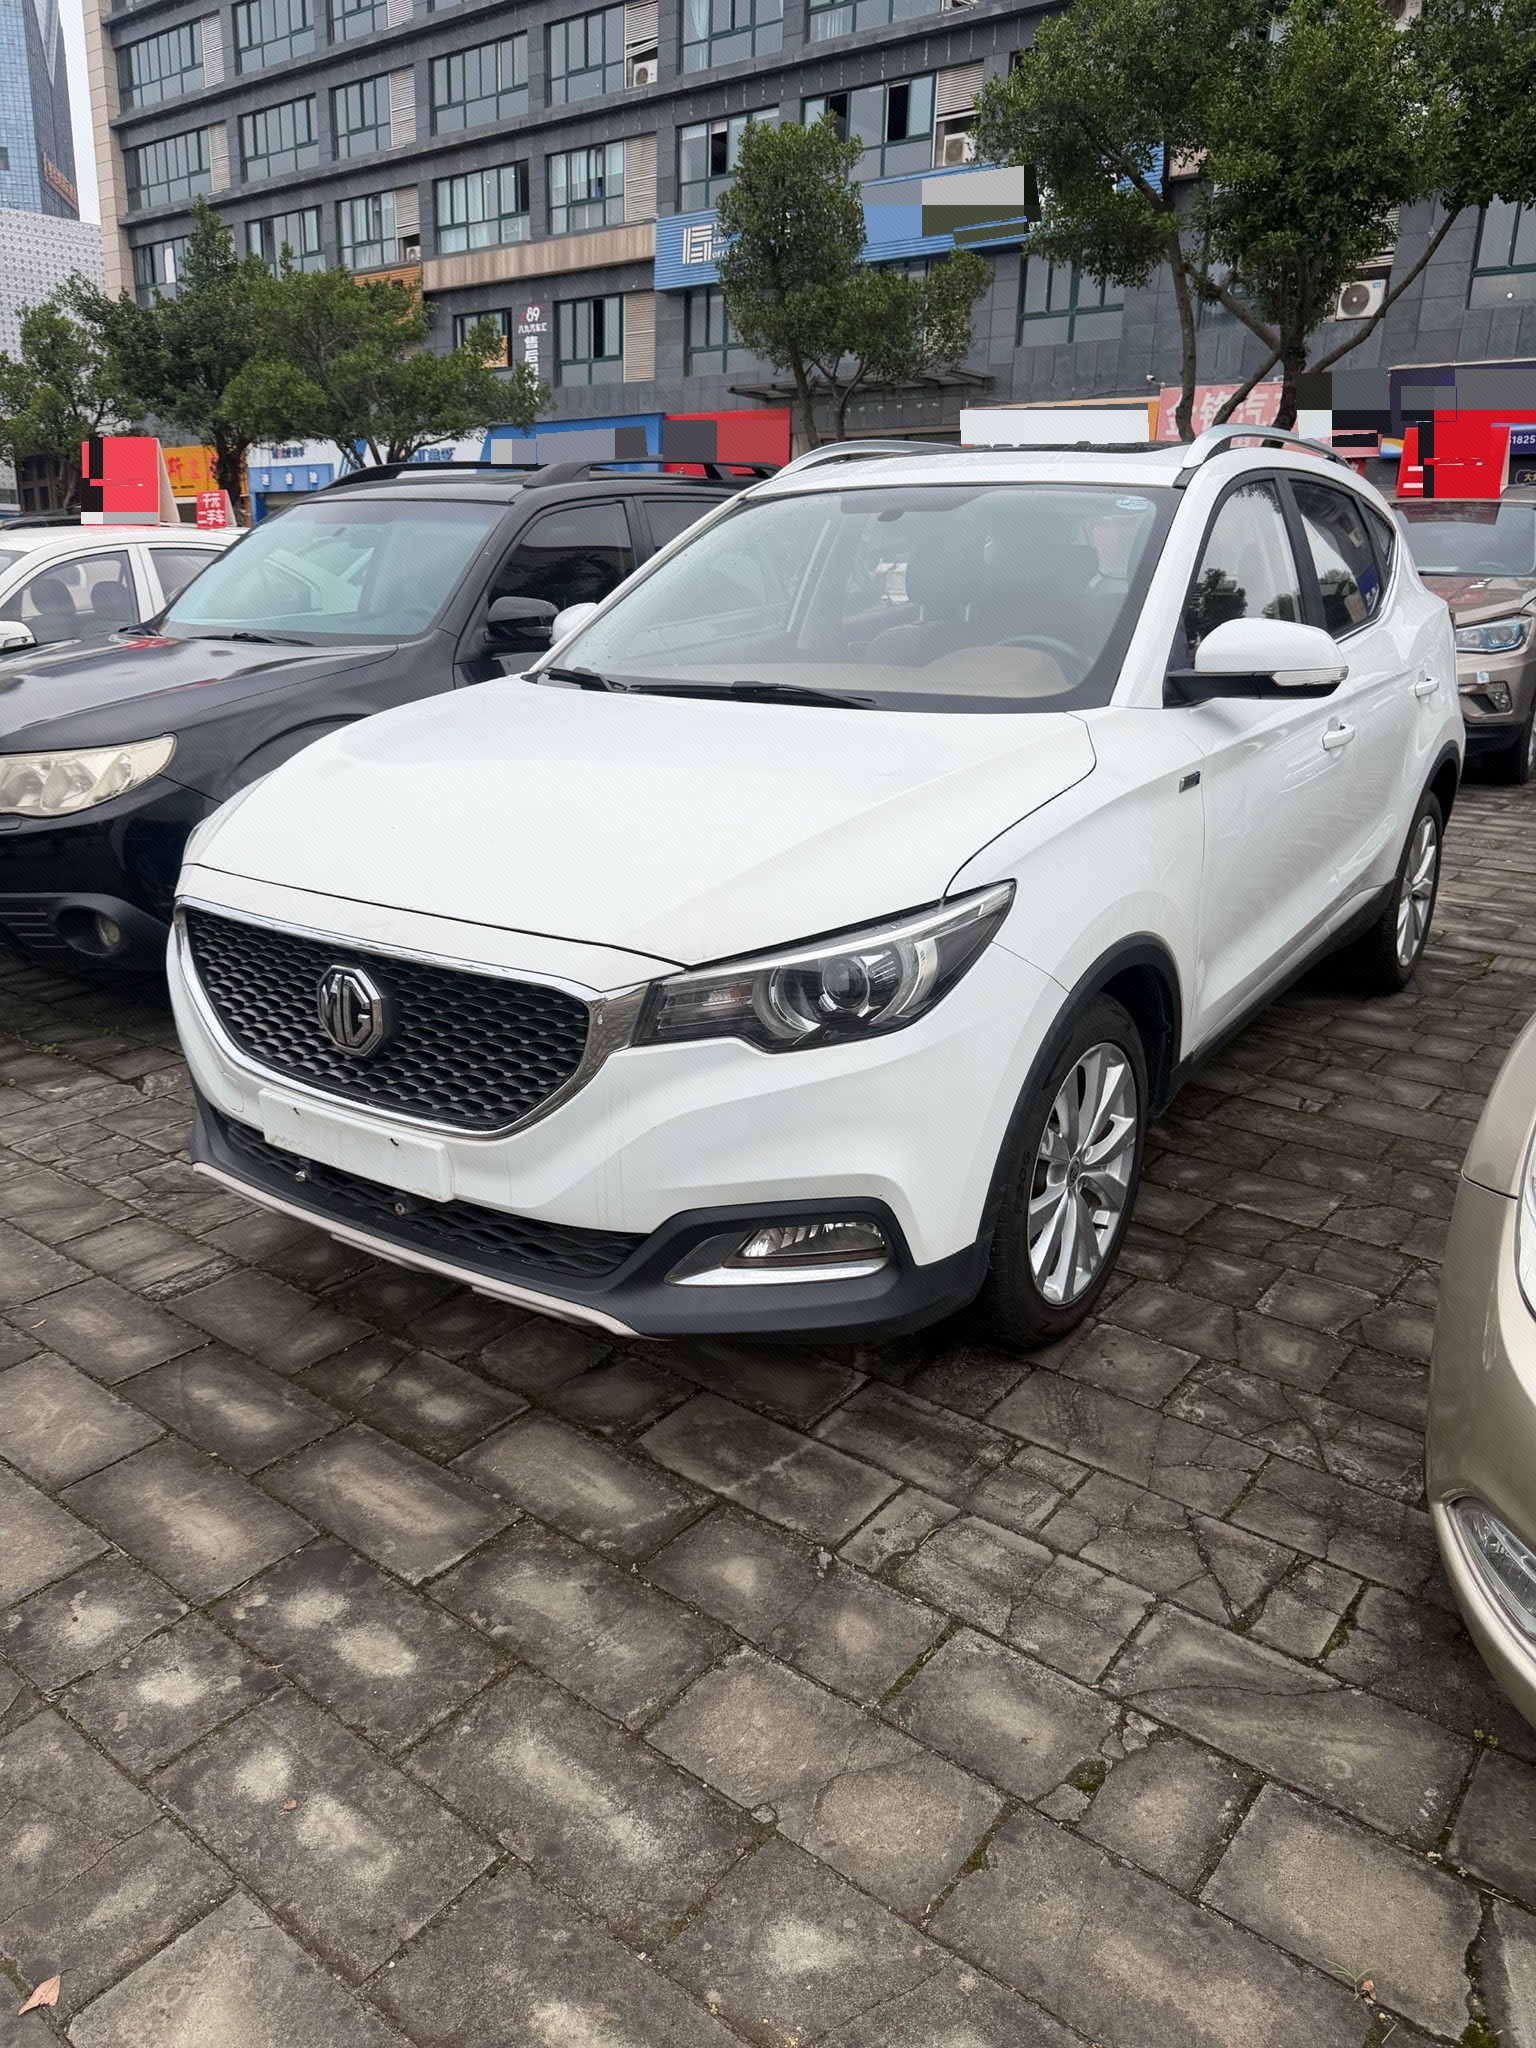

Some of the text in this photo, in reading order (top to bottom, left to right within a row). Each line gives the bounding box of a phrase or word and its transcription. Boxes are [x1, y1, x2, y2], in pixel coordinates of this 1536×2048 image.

[525, 306, 540, 322] 89
[1508, 435, 1536, 445] 1825
[197, 509, 225, 525] 二手车
[321, 970, 374, 1049] MG
